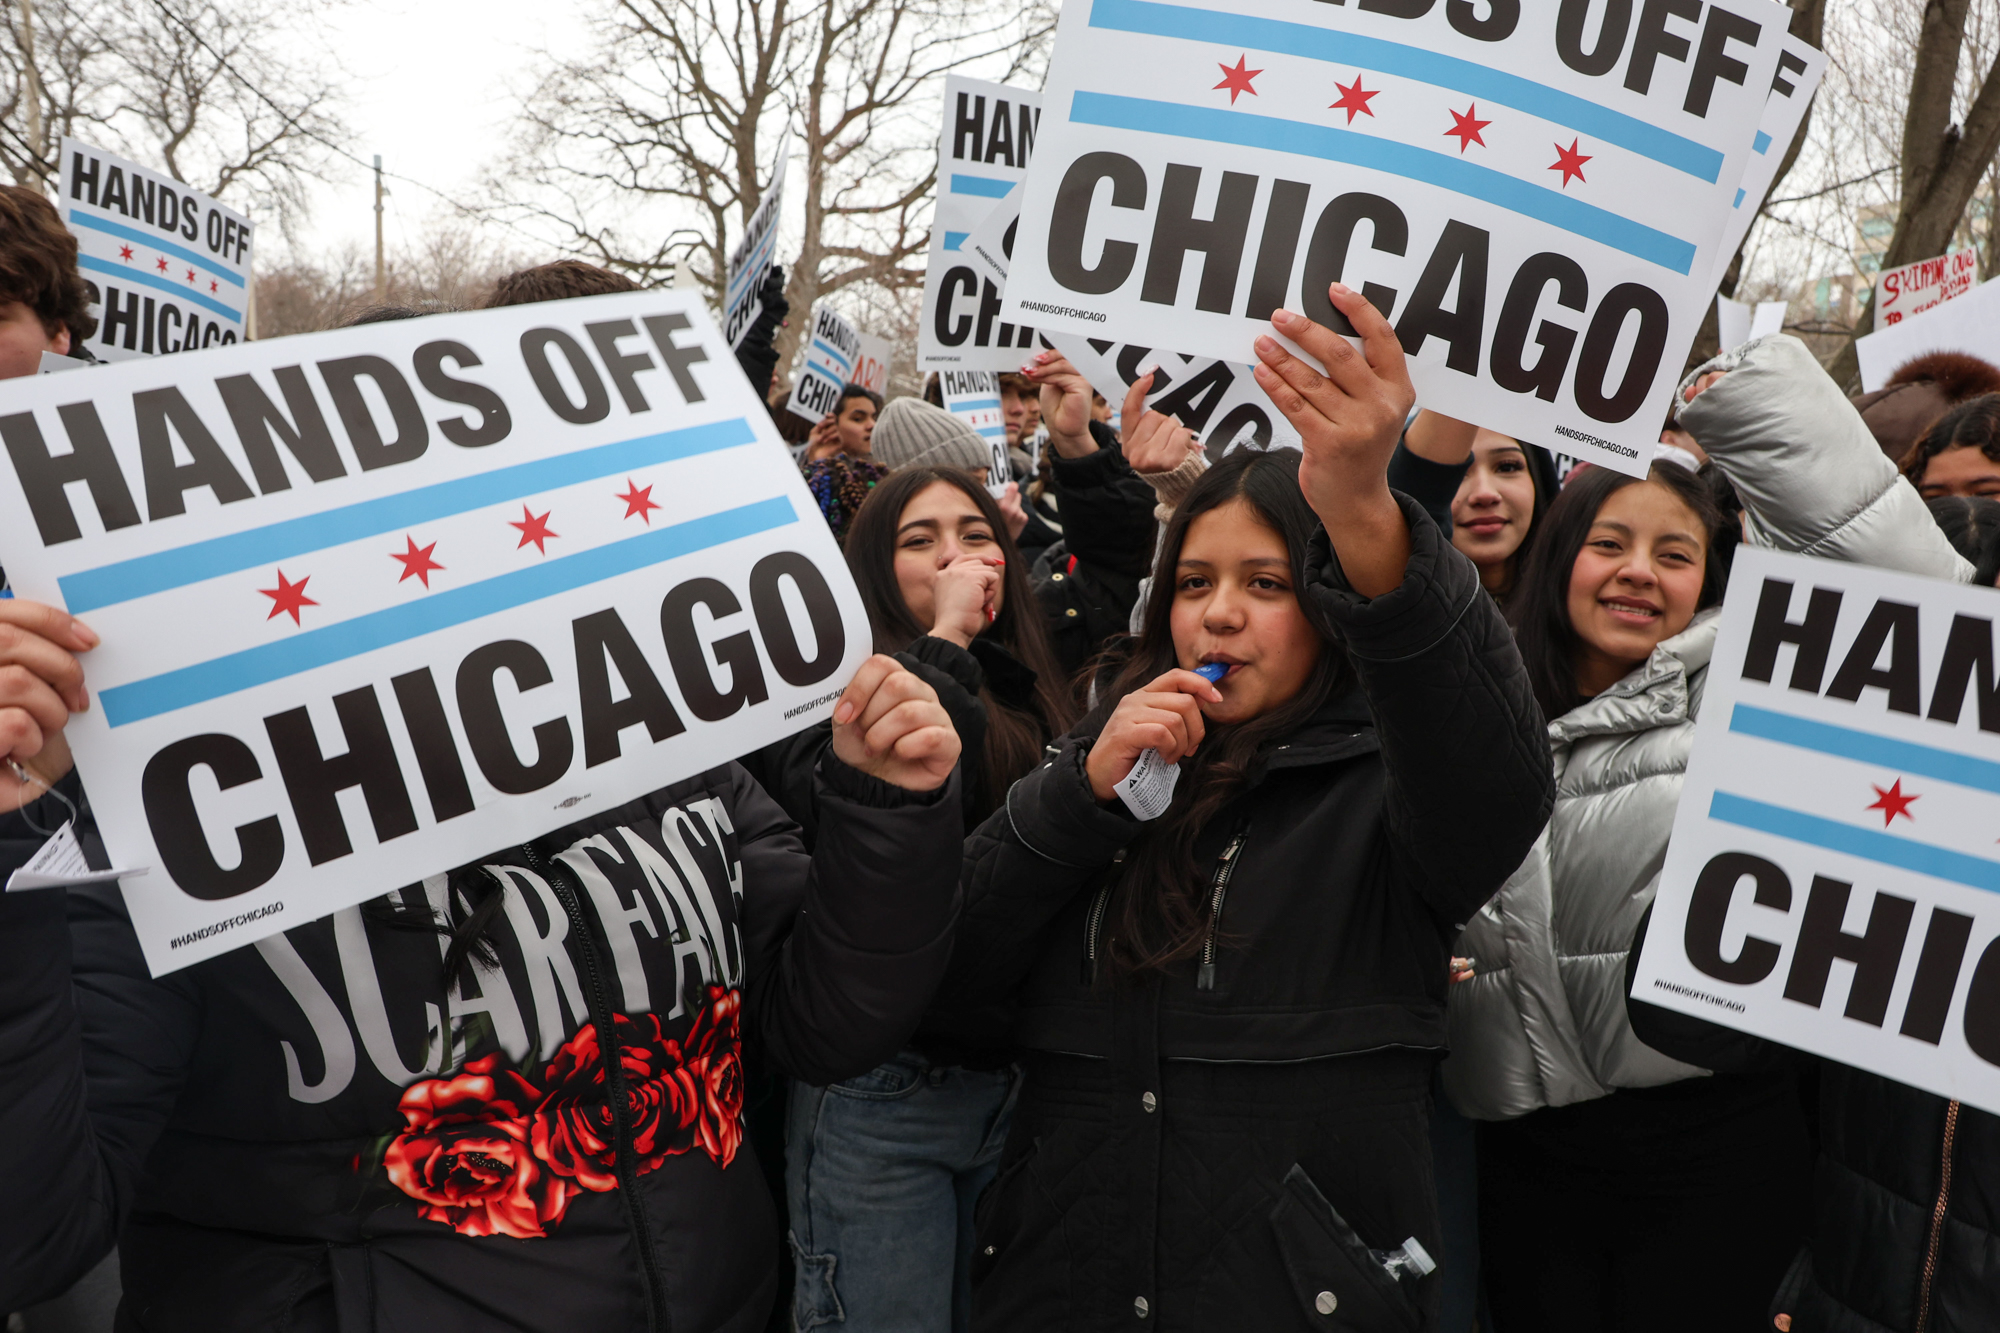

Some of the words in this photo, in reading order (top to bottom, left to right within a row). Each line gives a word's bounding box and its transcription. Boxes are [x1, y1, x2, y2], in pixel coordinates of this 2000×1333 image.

[1555, 0, 1762, 118] OFF
[71, 151, 198, 241] HANDS
[207, 208, 249, 265] OFF
[1020, 300, 1107, 323] #HANDSOFFCHICAGO
[1047, 152, 1668, 423] CHICAGO
[0, 339, 512, 546] HANDS
[520, 312, 709, 424] OFF
[1554, 425, 1638, 459] HANDSOFFCHICAGO.COM
[141, 550, 847, 901] CHICAGO
[170, 901, 284, 951] #HANDSOFFCHICAGO
[1654, 978, 1746, 1014] #HANDSOFFCHICAGO
